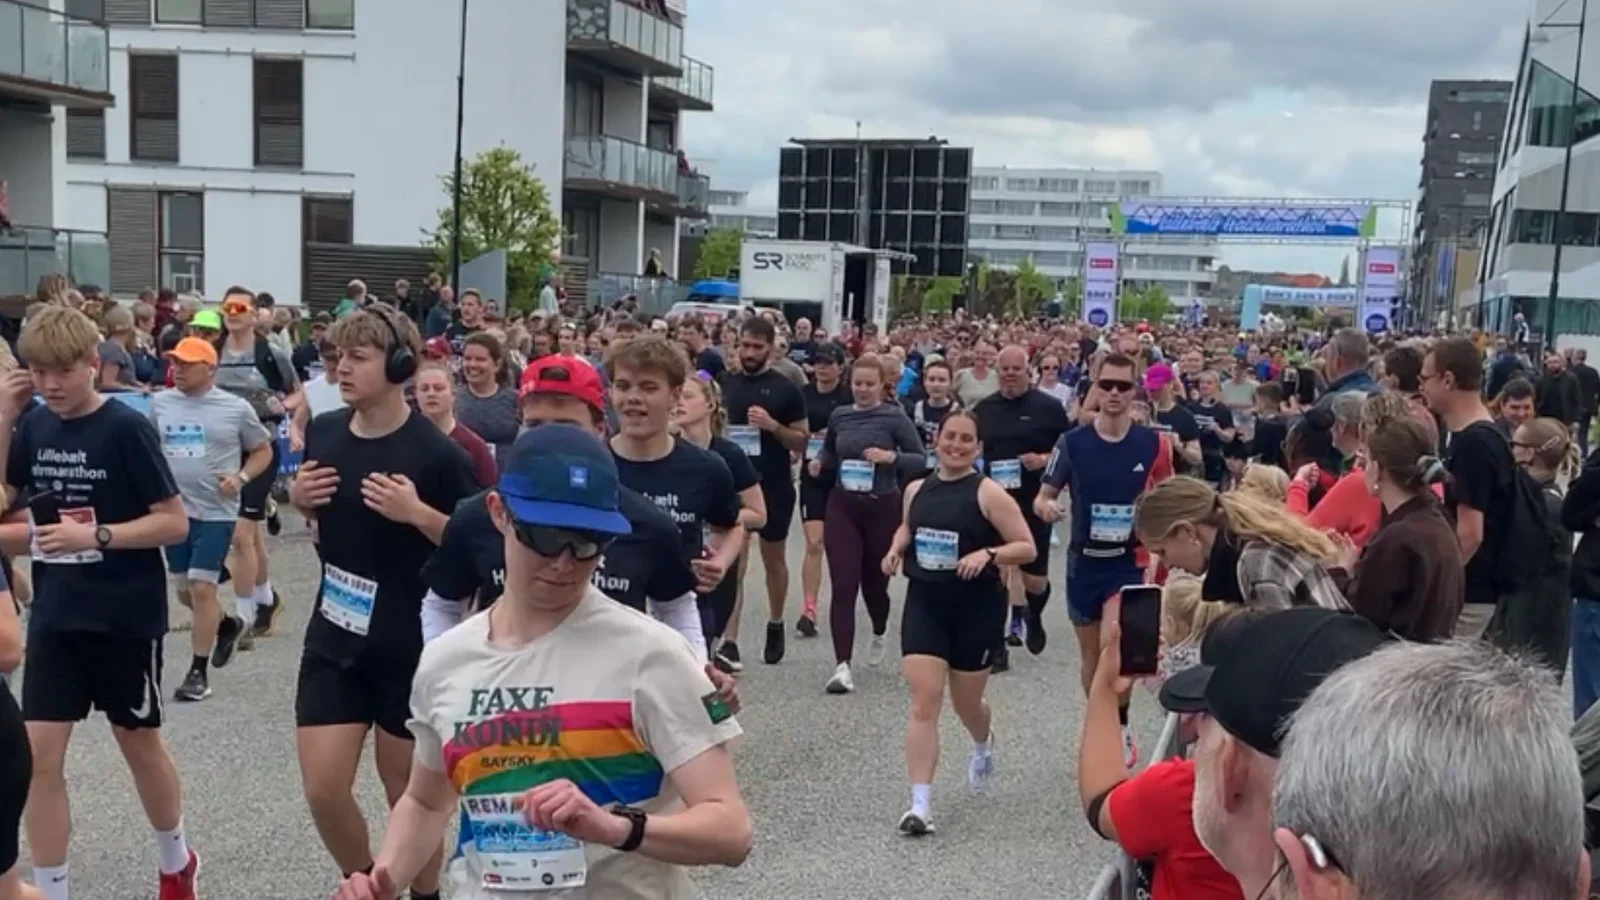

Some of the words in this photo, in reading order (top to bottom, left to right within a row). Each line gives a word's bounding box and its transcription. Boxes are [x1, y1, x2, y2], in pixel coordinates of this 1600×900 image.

[753, 252, 783, 270] SR
[468, 686, 554, 716] FAXE
[453, 717, 562, 747] KONDI
